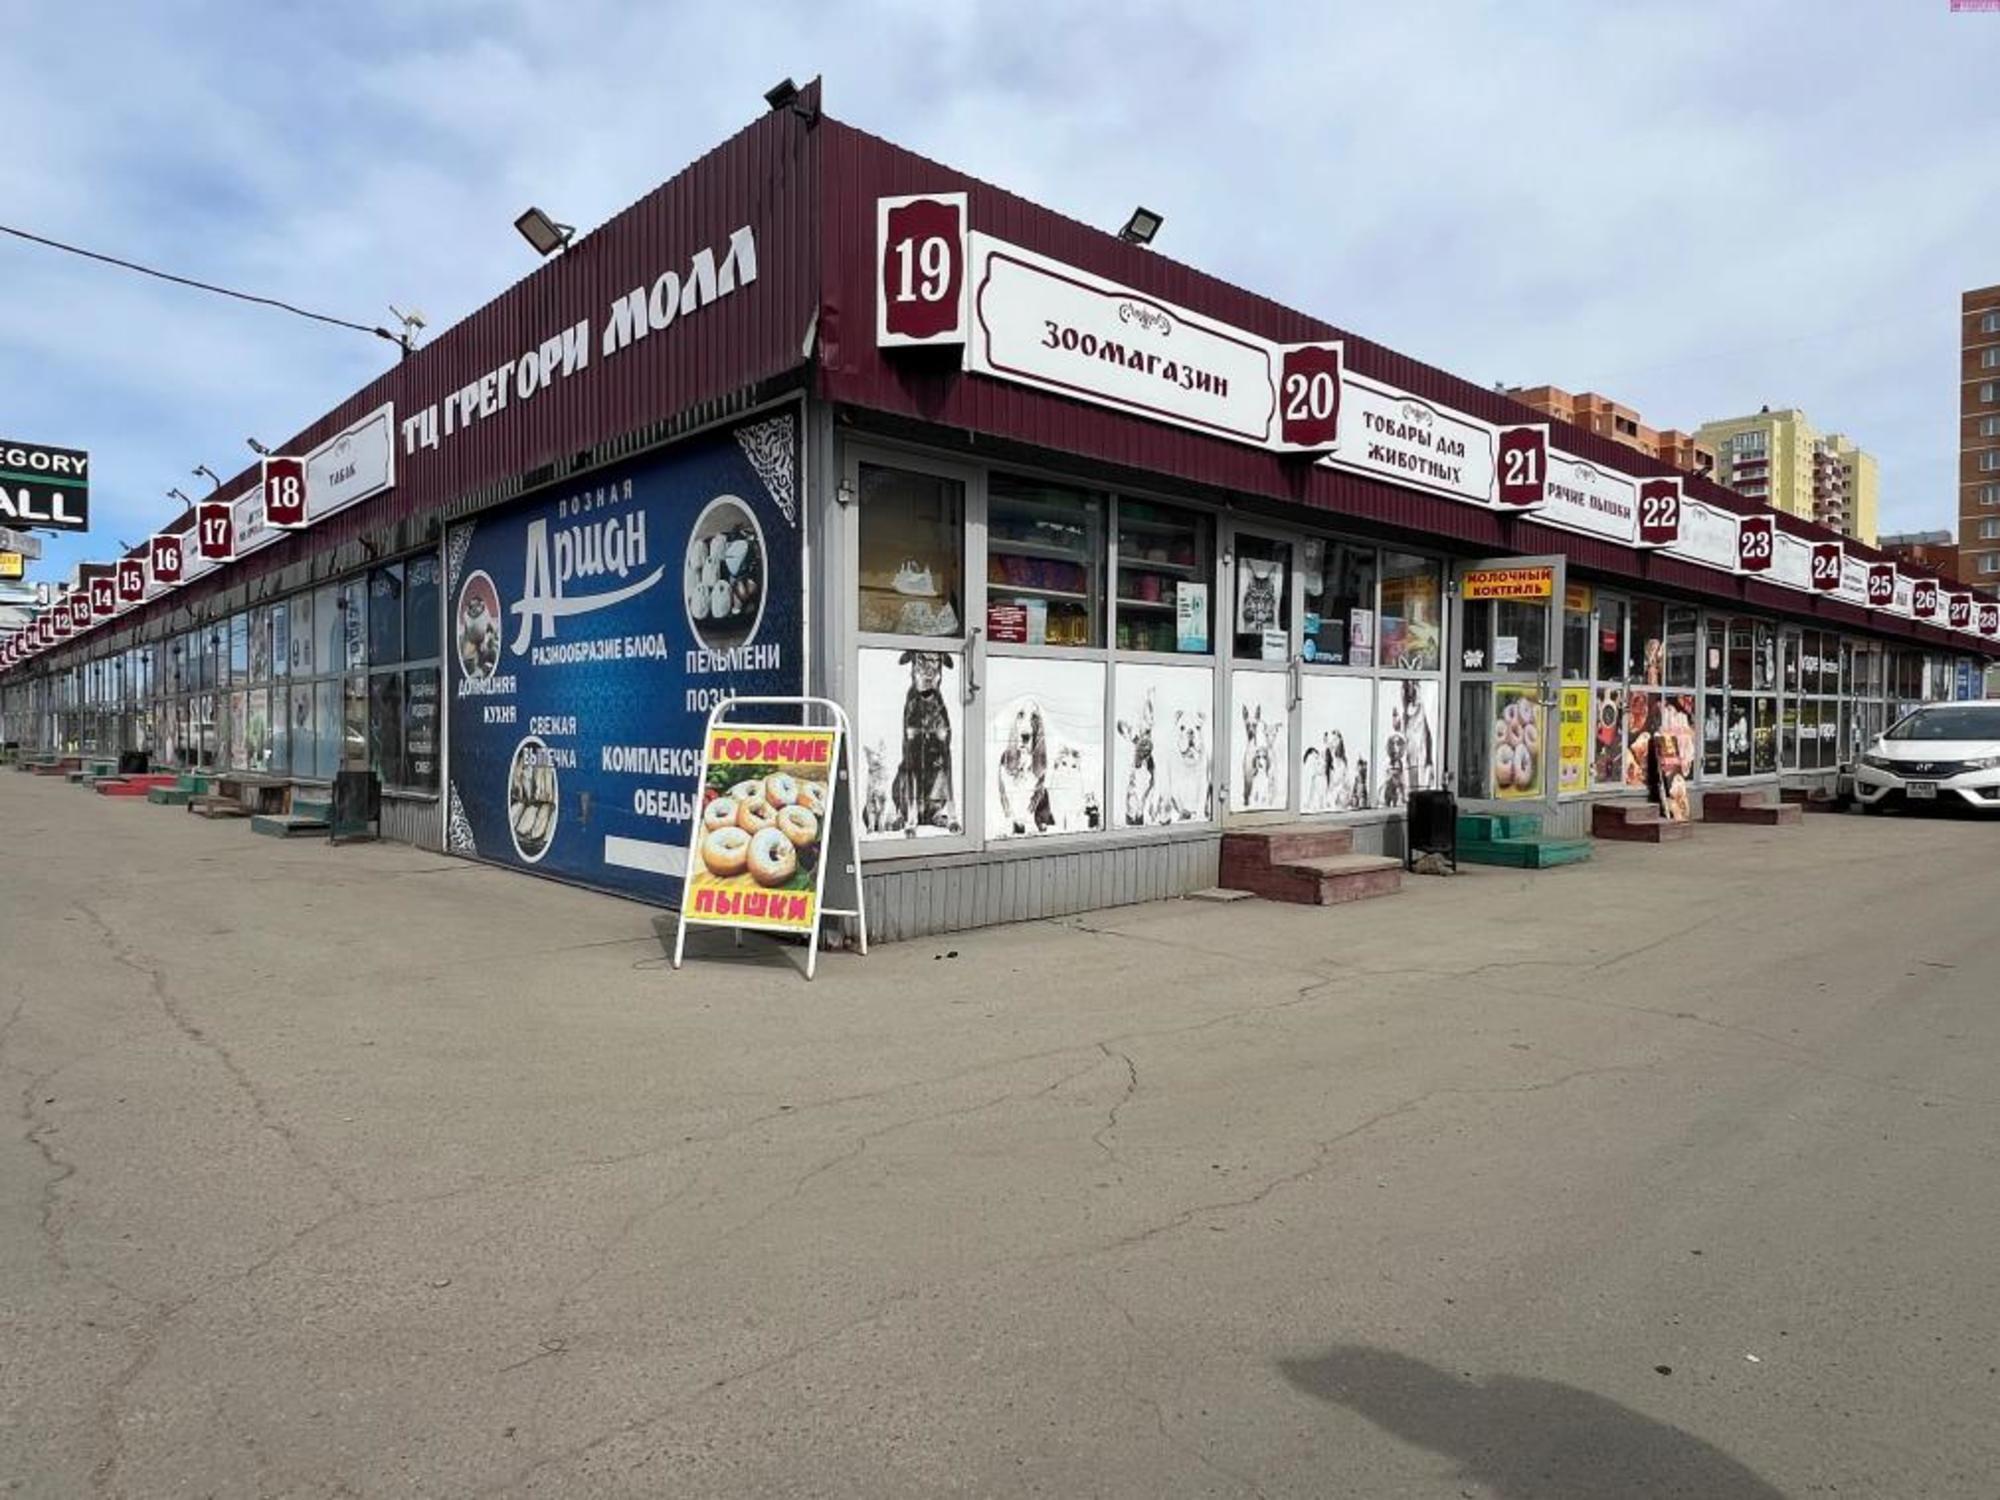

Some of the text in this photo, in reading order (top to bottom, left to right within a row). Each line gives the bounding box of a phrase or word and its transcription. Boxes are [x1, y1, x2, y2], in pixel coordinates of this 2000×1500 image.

[895, 236, 951, 302] 19
[402, 225, 757, 455] ТЦ ГРЕГОРИ МОЛЛ
[1041, 320, 1228, 397] ЗООМАГАЗИН
[1286, 373, 1334, 420] 20
[1363, 411, 1465, 458] ТОВАРЫ ДЛЯ
[1368, 442, 1461, 485] ЖИВОТНЫХ
[1505, 448, 1537, 486] 21
[270, 476, 299, 507] 18
[559, 478, 633, 519] ПОЗНАЯ
[1643, 496, 1676, 527] 22
[203, 518, 227, 545] 17
[1742, 531, 1770, 557] 23
[156, 548, 178, 571] 16
[1813, 555, 1840, 579] 24
[122, 571, 141, 591] 15
[510, 510, 666, 656] Аршан
[1468, 568, 1551, 583] МОЛОЧНЫЙ
[1870, 575, 1893, 597] 25
[94, 588, 112, 606] 14
[1915, 590, 1936, 609] 26
[55, 613, 69, 629] 12
[73, 603, 88, 619] 13
[1951, 602, 1969, 620] 27
[1980, 611, 1997, 628] 28
[531, 633, 667, 666] РАЗНООБРАЗИЕ БЛЮД
[686, 644, 780, 674] ПЕЛЬМЕНИ
[458, 675, 517, 699] ДОМАШНЯЯ
[686, 687, 736, 713] ПОЗЫ
[484, 705, 517, 723] КУХНЯ
[530, 715, 577, 735] СВЕЖАЯ
[523, 746, 577, 769] ВЫПЕЧКА
[712, 736, 830, 763] ГОРЯЧИЕ
[694, 889, 808, 920] ПЫШКИ
